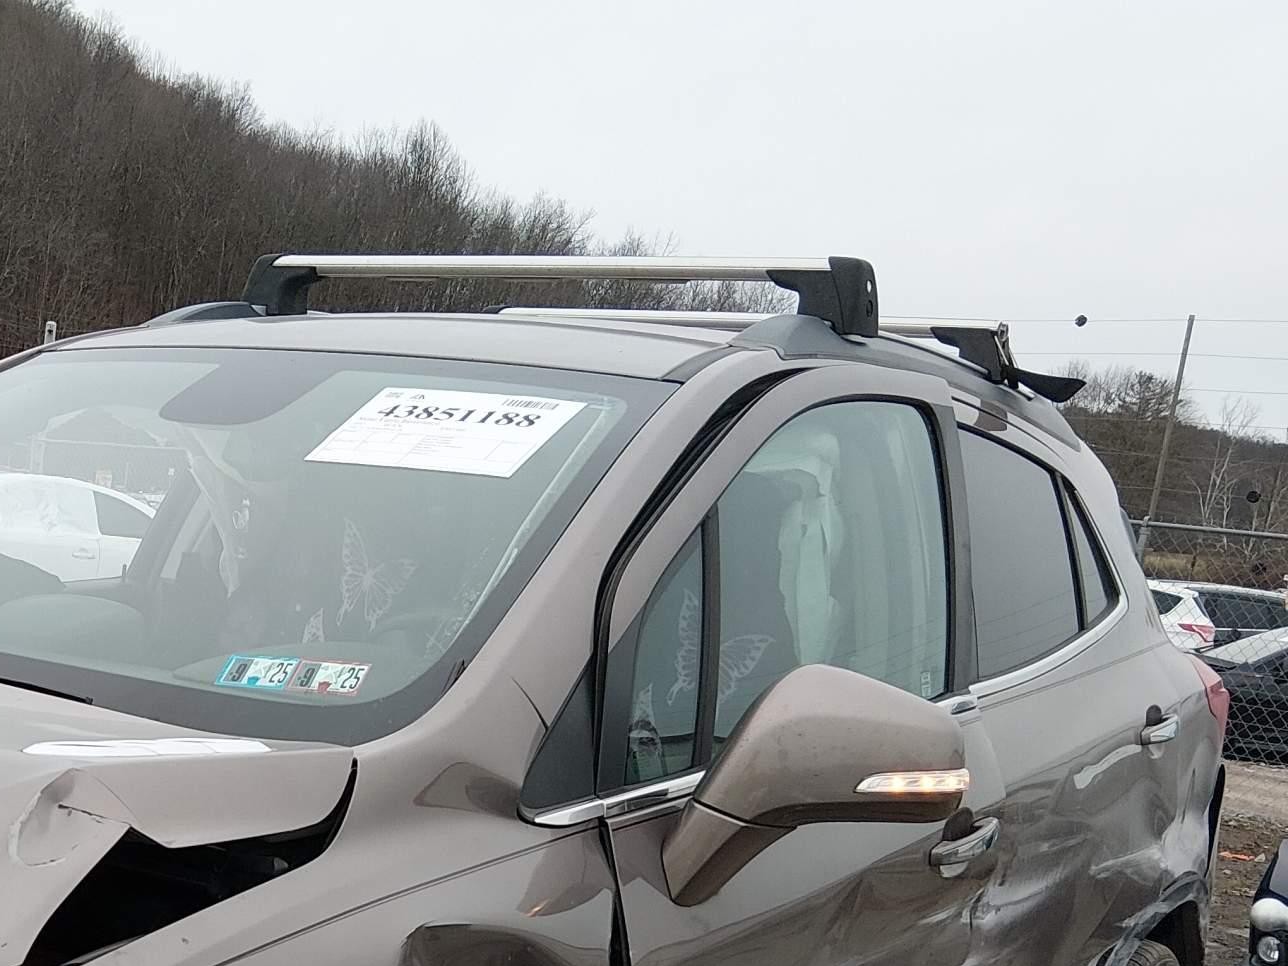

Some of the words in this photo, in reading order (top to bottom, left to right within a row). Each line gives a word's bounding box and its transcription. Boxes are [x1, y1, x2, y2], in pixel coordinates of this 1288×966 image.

[377, 404, 541, 427] 43851188
[268, 662, 293, 684] 25
[340, 667, 365, 690] 25
